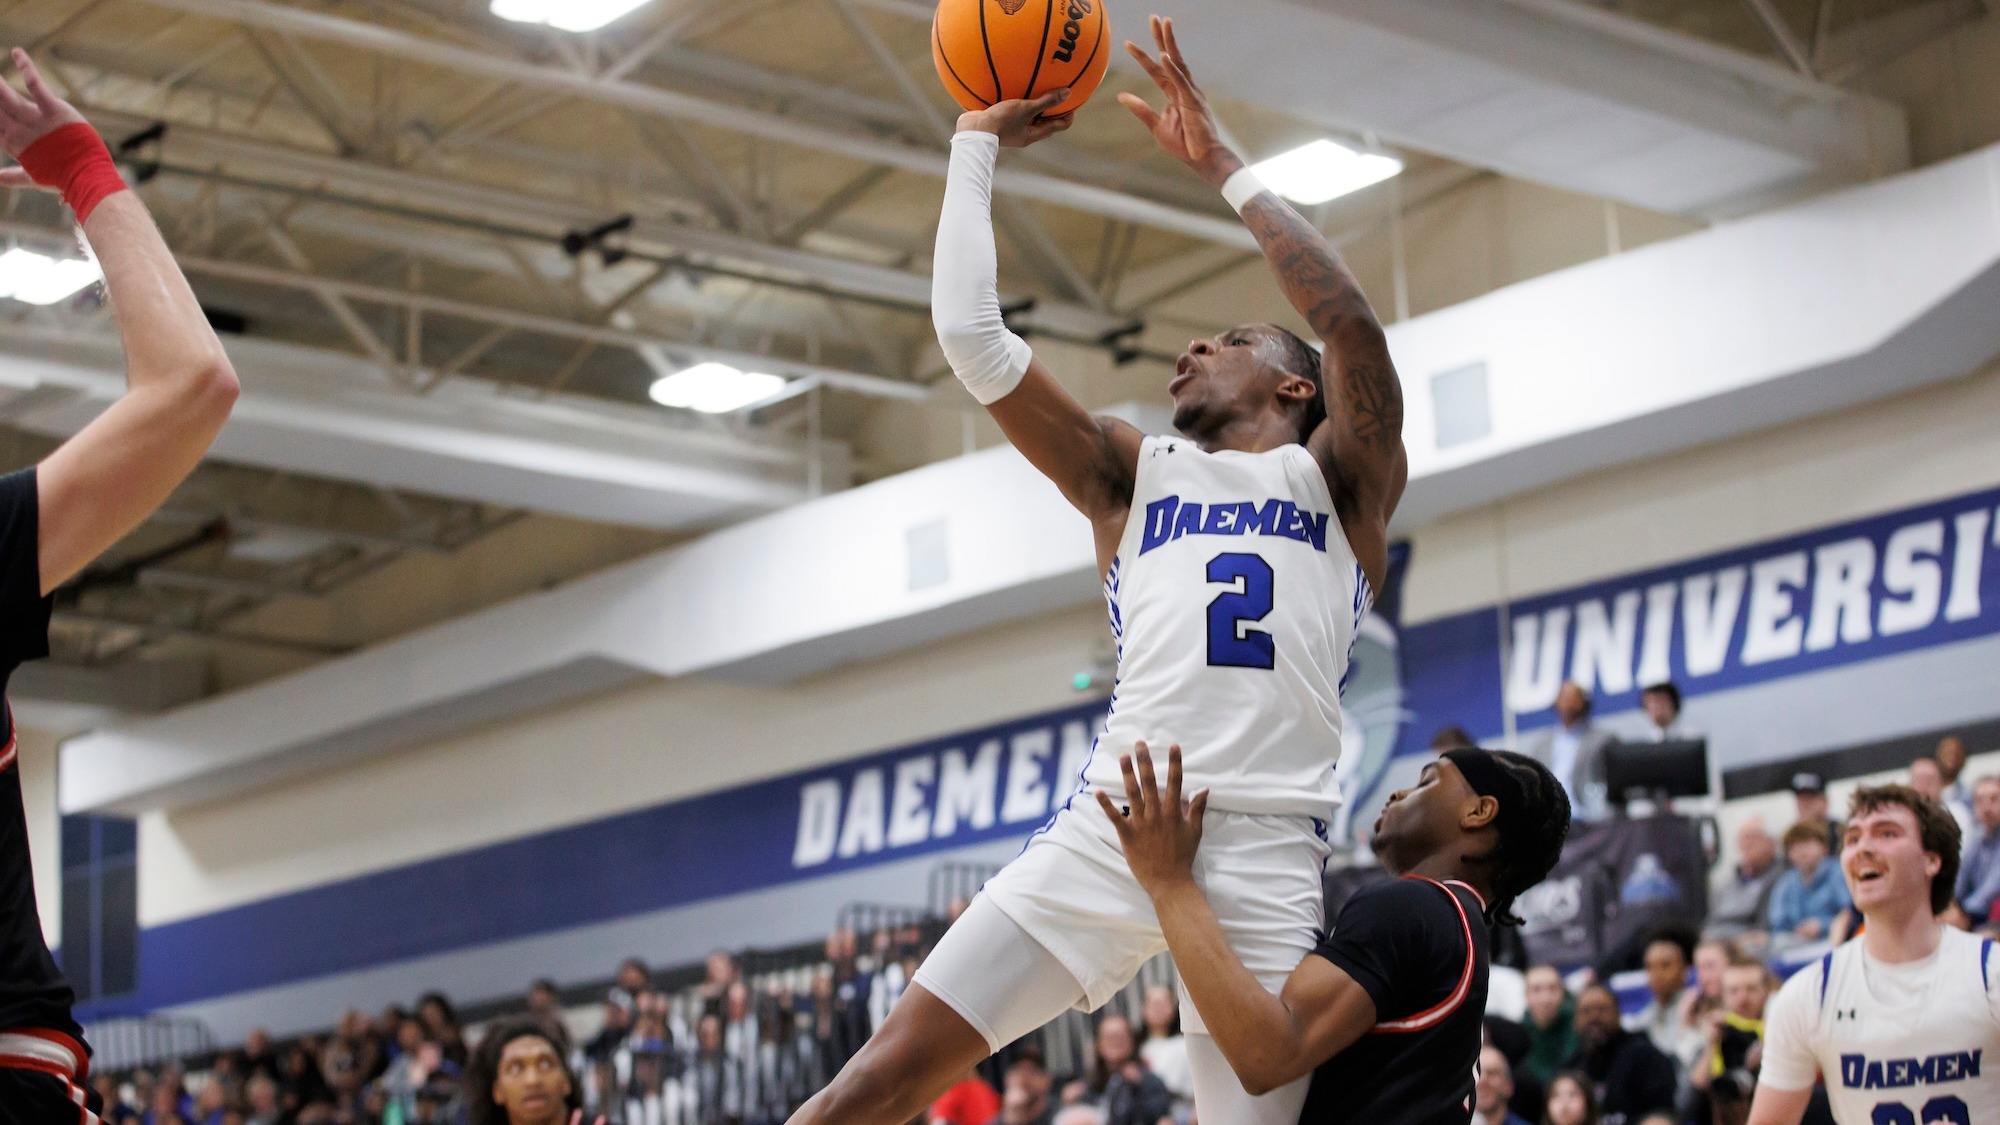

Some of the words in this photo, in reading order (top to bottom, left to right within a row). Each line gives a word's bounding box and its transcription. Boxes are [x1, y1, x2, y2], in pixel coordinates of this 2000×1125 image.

[1138, 494, 1329, 557] DAEMEN
[1206, 552, 1275, 670] 2
[1507, 506, 2000, 714] UNIVERSI
[1840, 1049, 1982, 1089] DAEMEN
